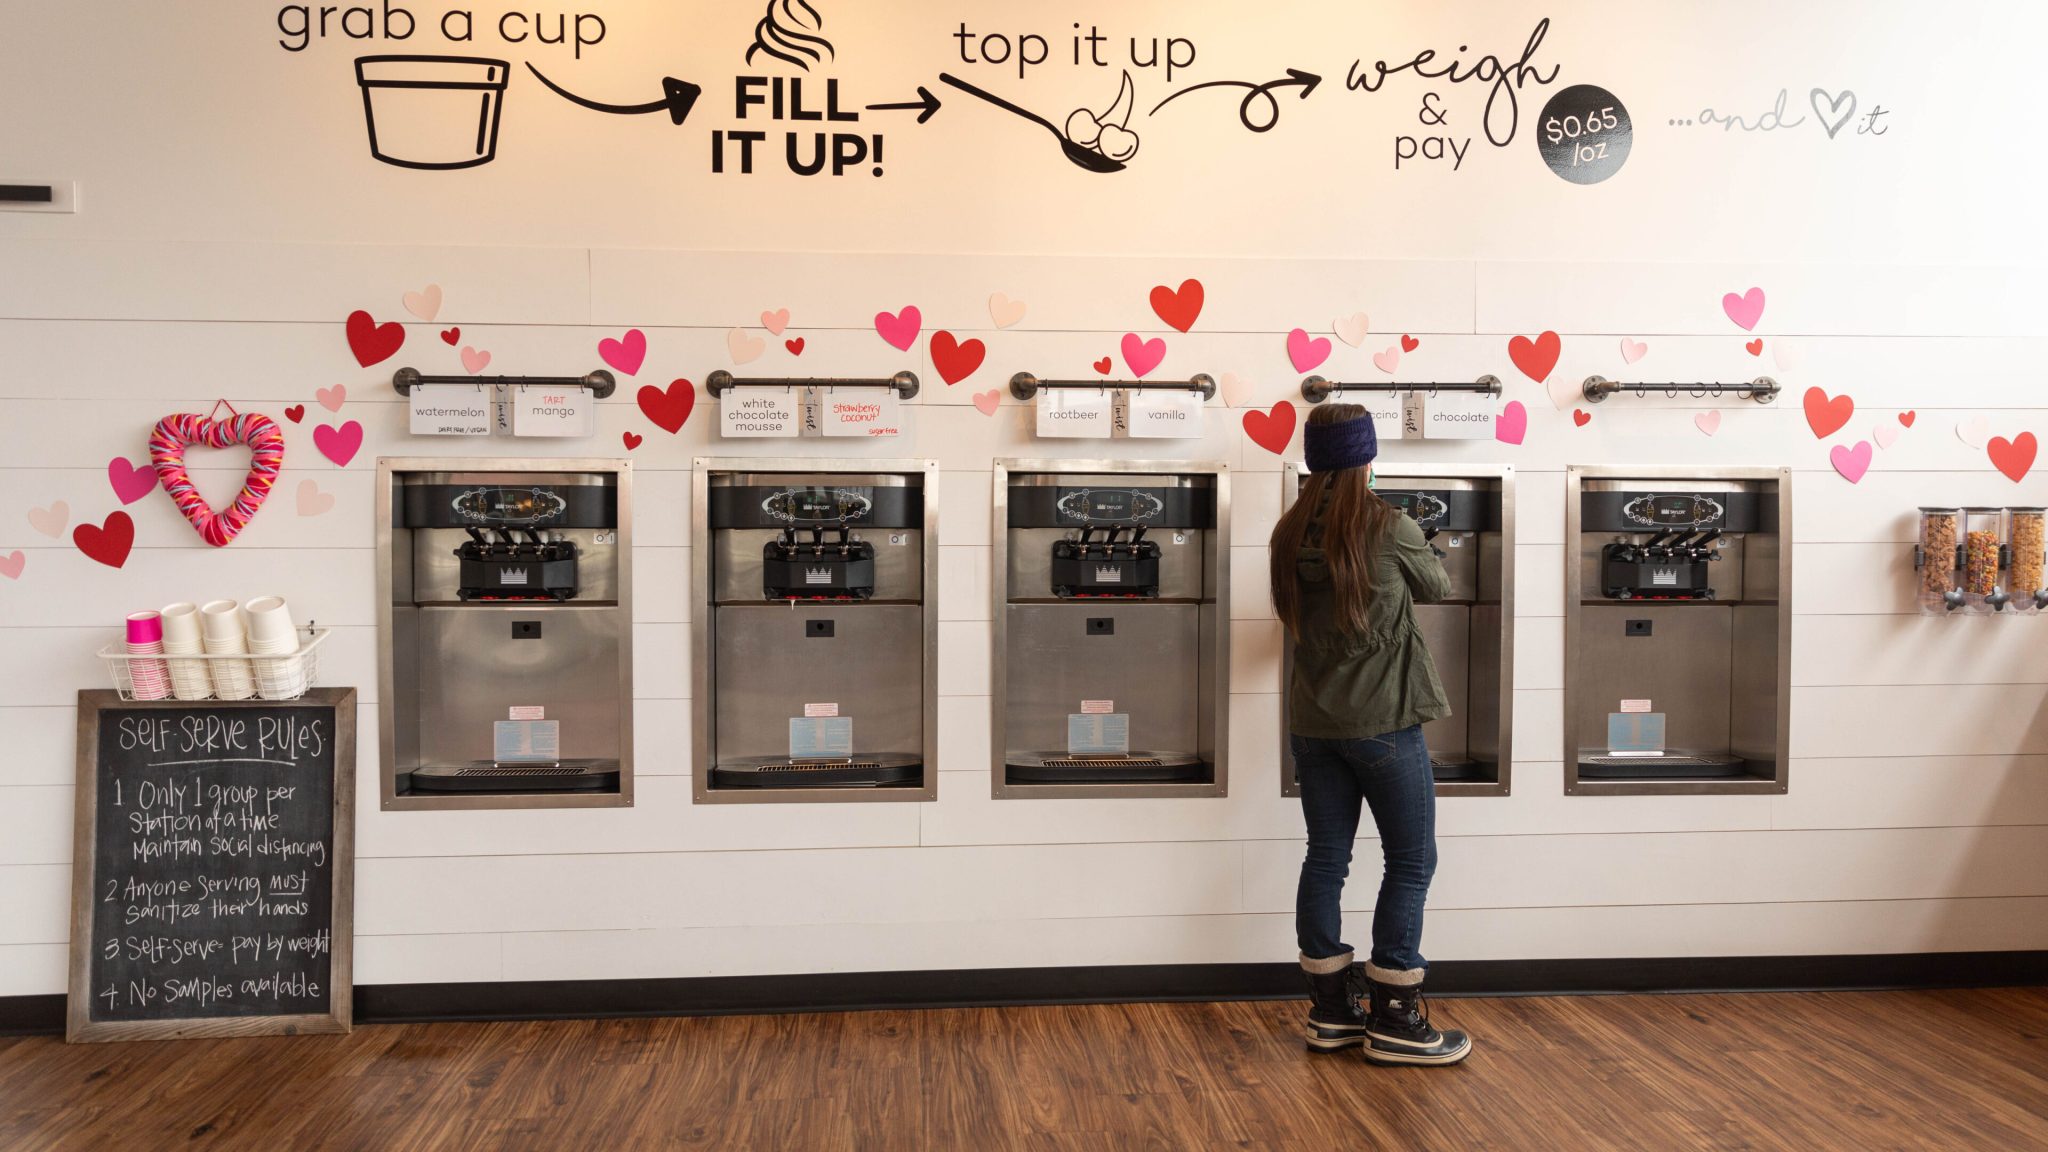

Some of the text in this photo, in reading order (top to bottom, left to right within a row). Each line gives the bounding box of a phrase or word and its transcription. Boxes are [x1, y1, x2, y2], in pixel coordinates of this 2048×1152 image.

[277, 0, 607, 60] grab a cup
[953, 22, 1197, 82] top it up
[1346, 17, 1561, 147] weigh
[735, 75, 859, 122] FILL
[1418, 92, 1448, 126] &
[1545, 106, 1618, 145] $0.65
[1856, 105, 1890, 136] it
[711, 130, 884, 178] IT UP!
[1394, 135, 1472, 171] pay
[1572, 140, 1609, 168] /oz
[415, 407, 485, 417] watermelon
[532, 406, 575, 418] mango
[543, 395, 566, 405] TART
[728, 409, 789, 420] chocolate
[742, 398, 776, 409] white
[1049, 409, 1099, 420] rootbeer
[1147, 409, 1186, 420] vanilla
[735, 422, 783, 431] mousse
[840, 413, 878, 423] coconut
[1433, 411, 1490, 422] chocolate
[138, 777, 187, 815] Only
[193, 776, 203, 807] 1
[208, 784, 258, 818] group
[266, 785, 296, 815] per
[223, 815, 236, 827] a
[133, 833, 202, 863] Maintain
[256, 833, 326, 867] distancing
[104, 879, 118, 902] 2
[123, 875, 192, 907] Anyone
[207, 898, 247, 919] their
[257, 896, 308, 917] hands
[231, 935, 261, 965] pay
[267, 932, 284, 961] by
[287, 927, 332, 959] weight
[130, 977, 157, 1007] No
[240, 970, 320, 1001] available
